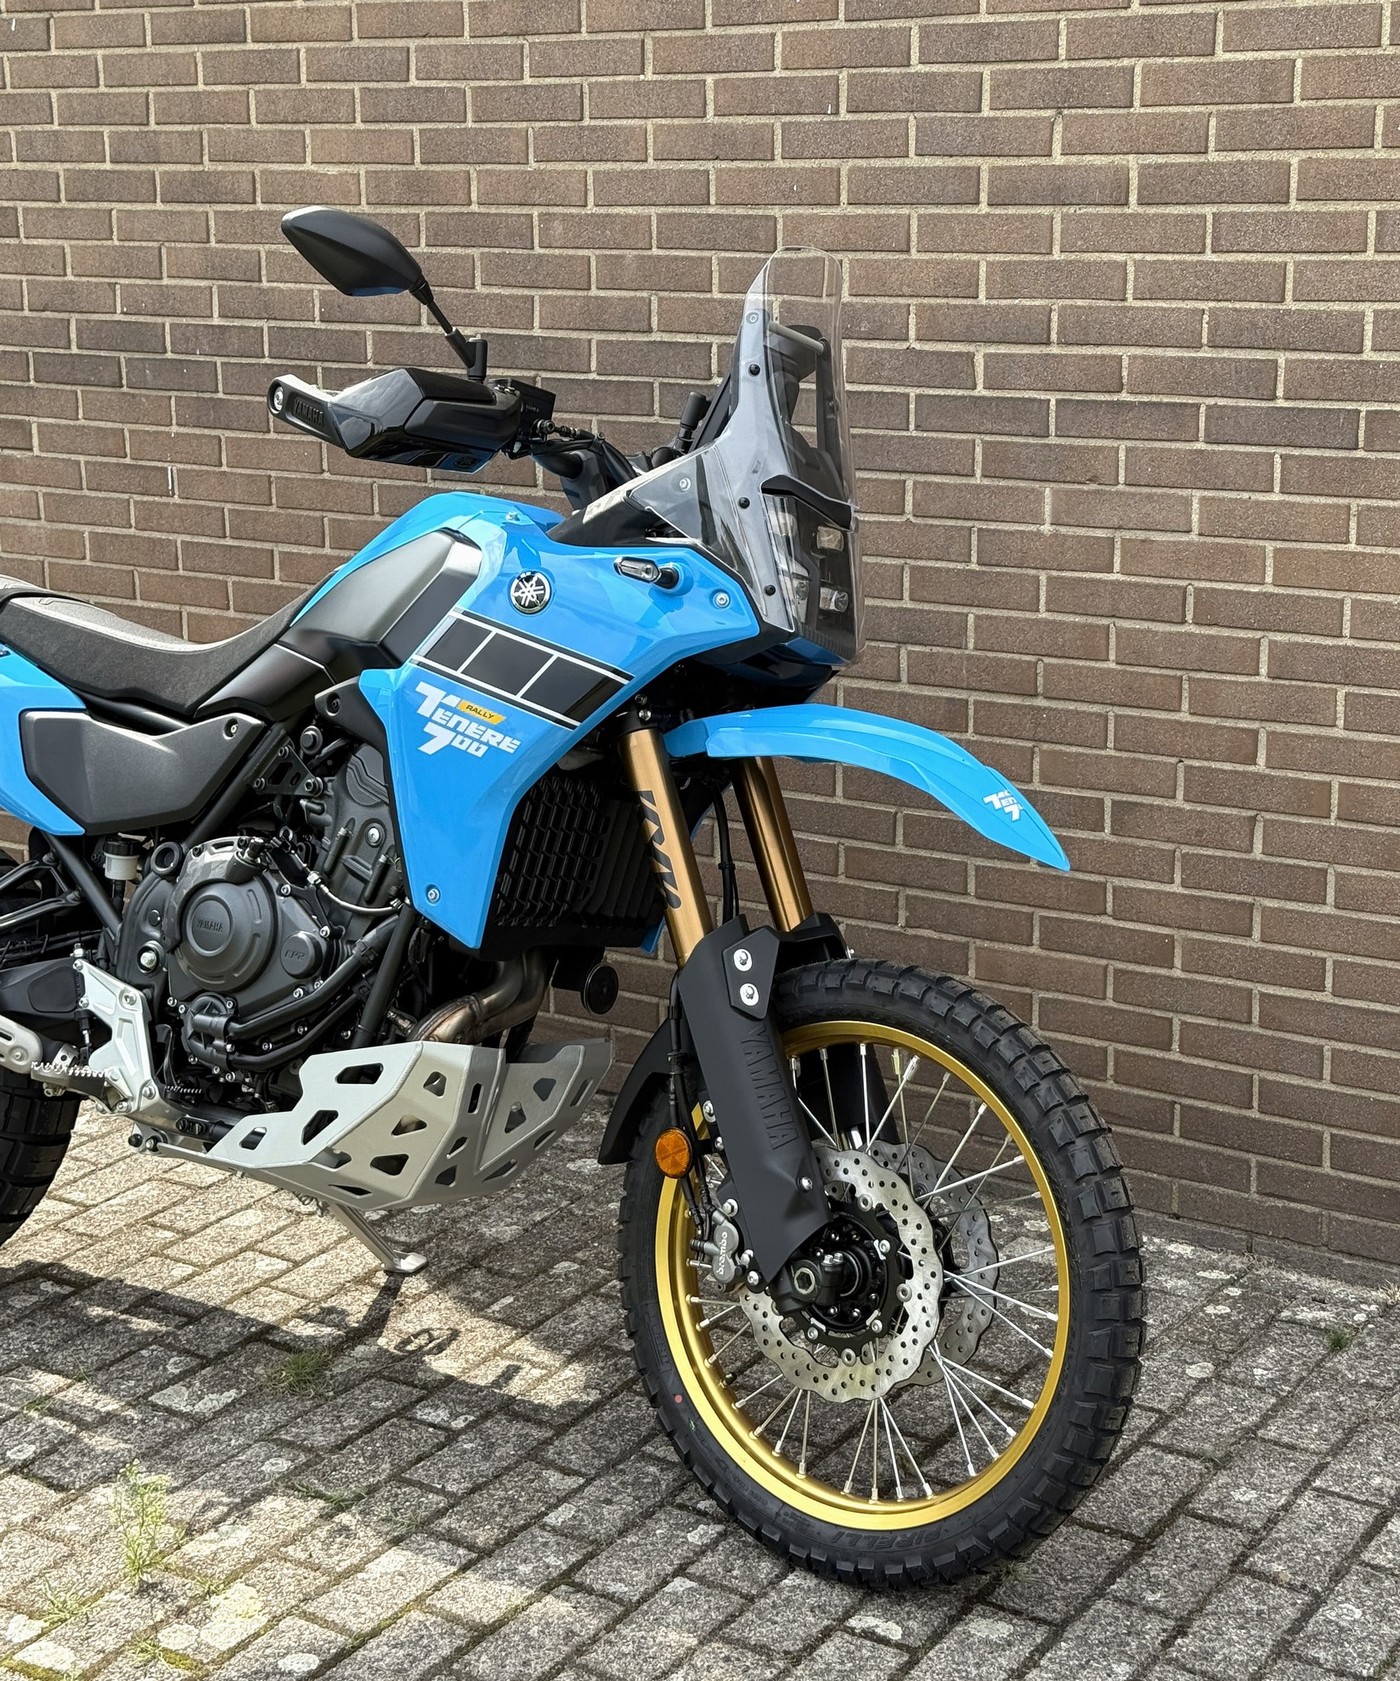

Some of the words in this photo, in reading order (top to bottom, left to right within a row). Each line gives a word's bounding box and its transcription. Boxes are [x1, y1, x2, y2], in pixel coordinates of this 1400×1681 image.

[465, 704, 495, 719] RALLY
[417, 721, 489, 758] 700
[741, 1020, 799, 1151] YAMAHA
[716, 1231, 728, 1275] brembo
[831, 1525, 948, 1550] PIRELLI
